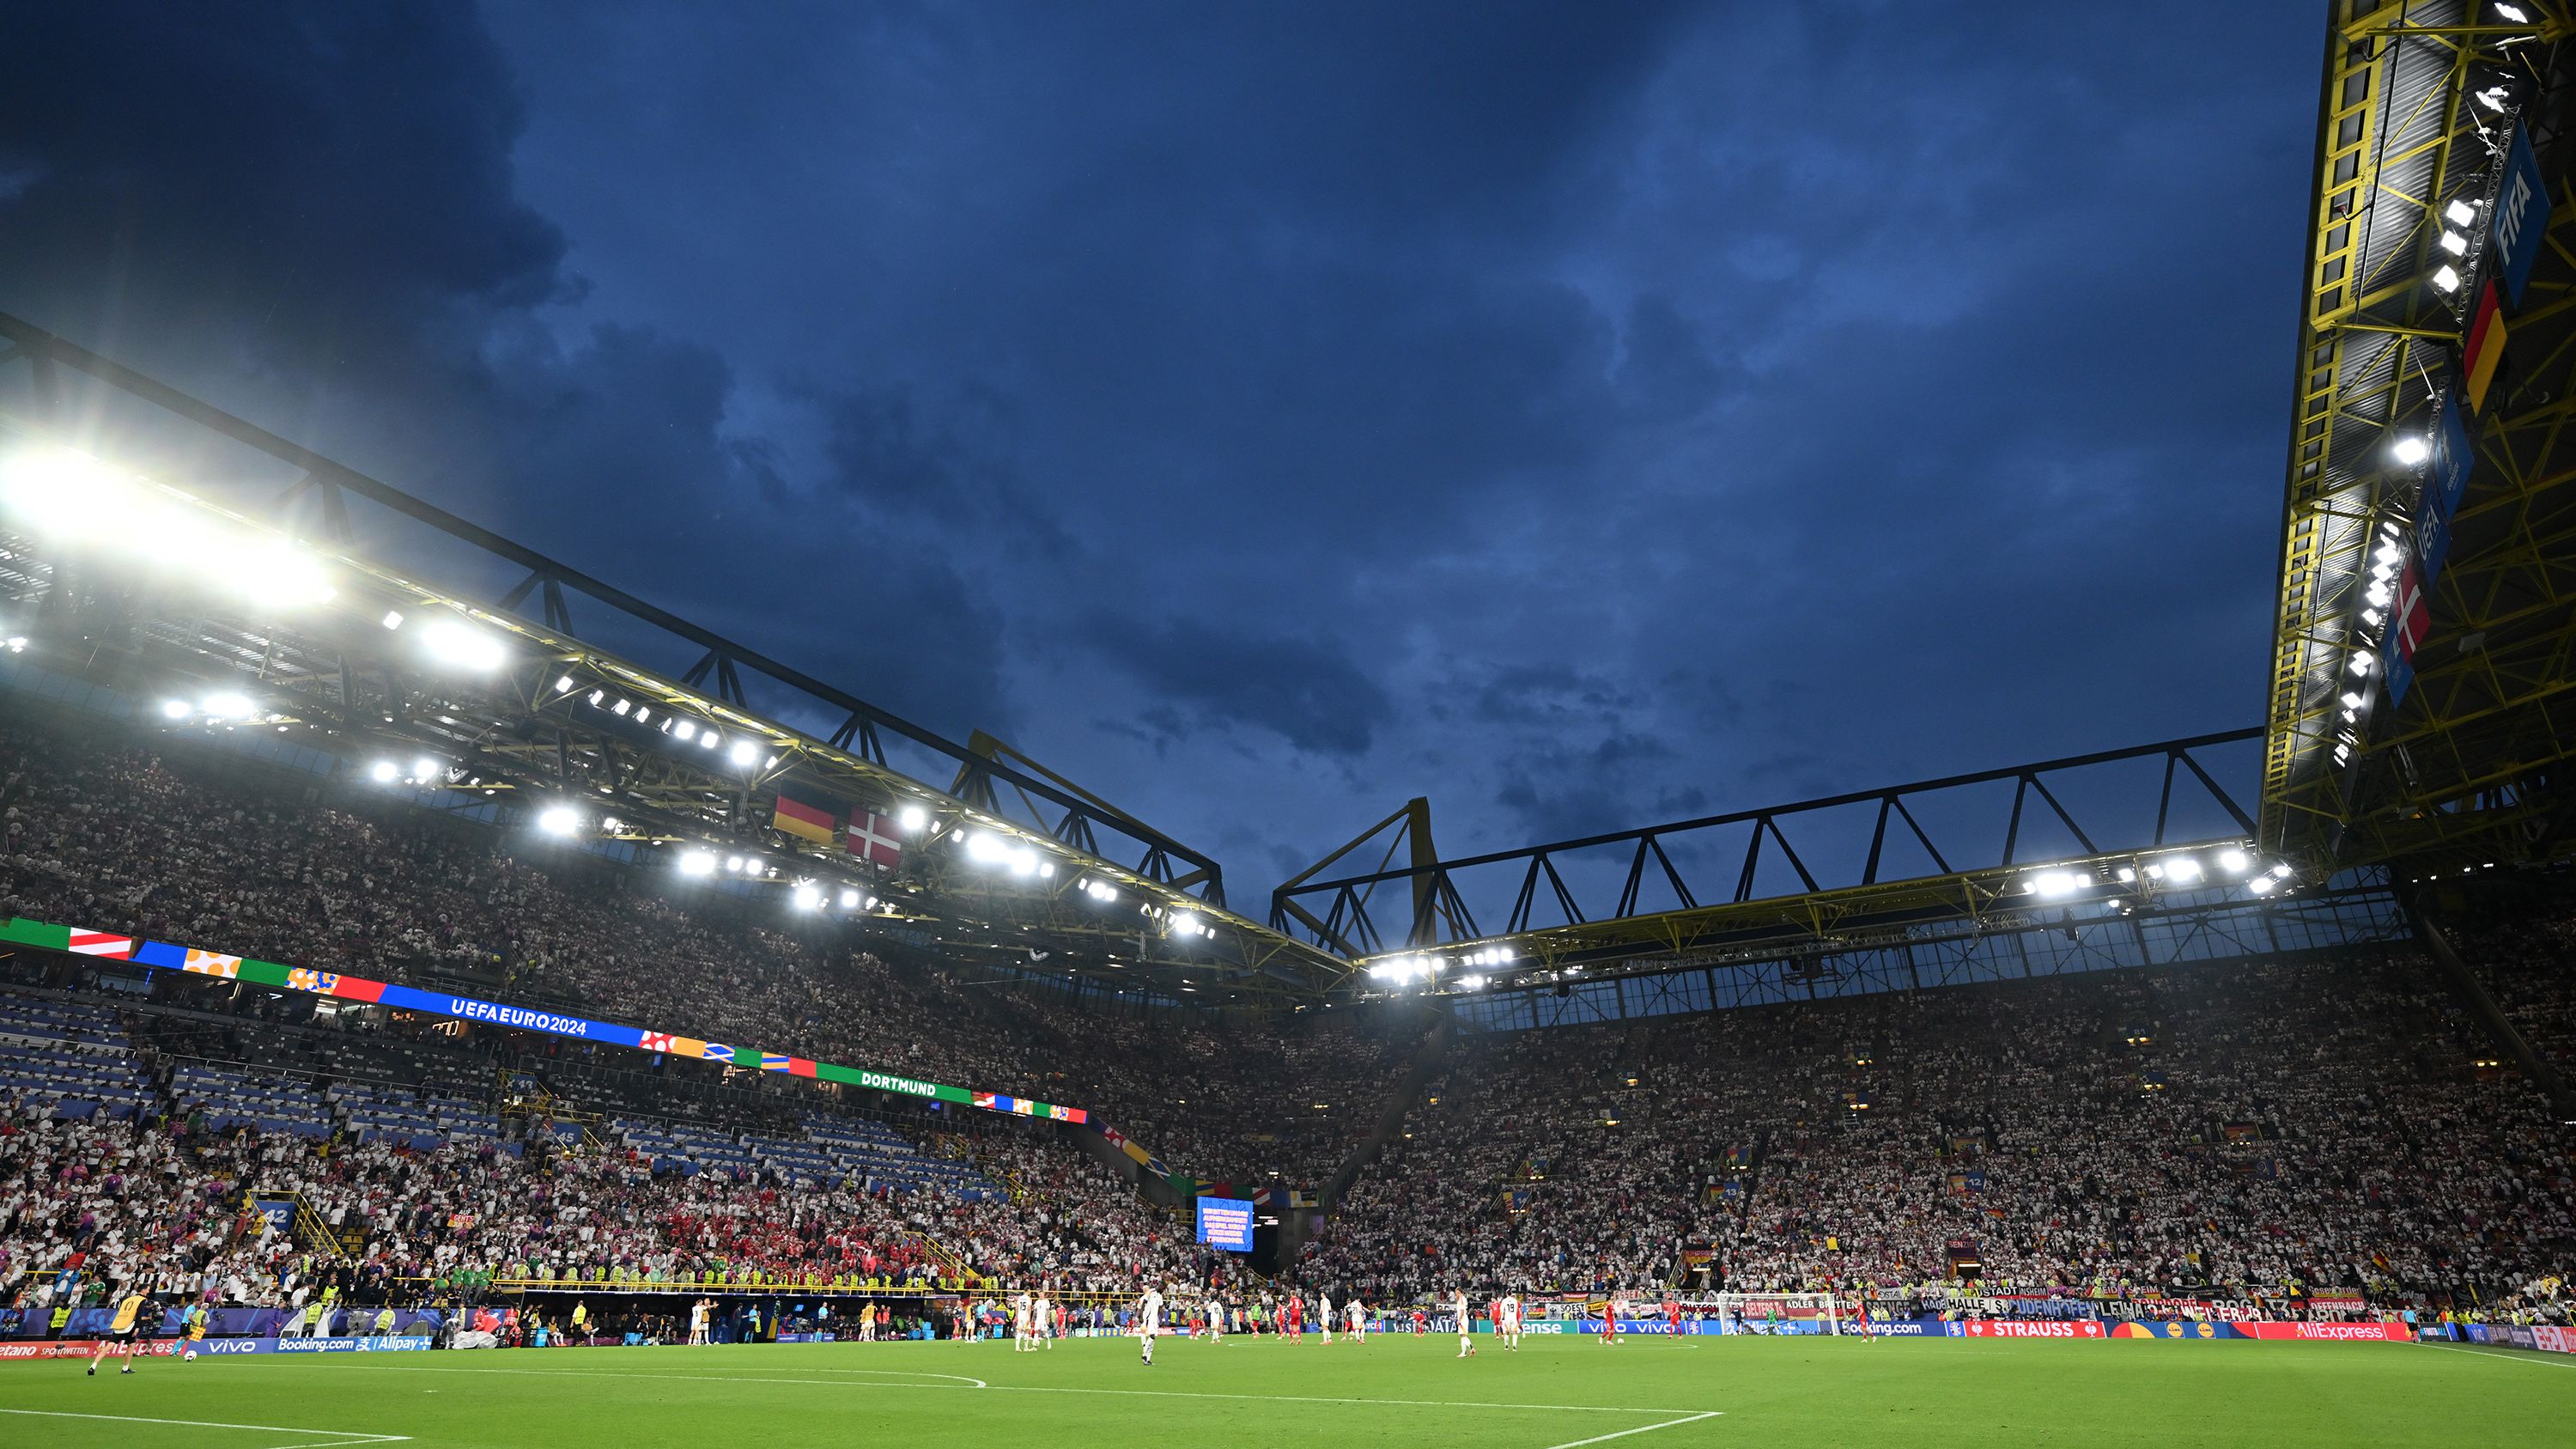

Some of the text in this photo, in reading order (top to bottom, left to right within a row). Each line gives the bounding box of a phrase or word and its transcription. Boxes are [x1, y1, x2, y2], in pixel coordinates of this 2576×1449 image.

[2499, 170, 2531, 267] FIFA
[2418, 504, 2439, 561] UEFA
[861, 1072, 936, 1096] DORTMUND
[565, 1131, 583, 1142] 45
[1968, 1178, 1982, 1186] 12
[1020, 1301, 1027, 1311] 15
[1506, 1303, 1515, 1312] 19
[1786, 1300, 1814, 1308] ADLER
[1948, 1299, 1986, 1311] HALLE
[1994, 1323, 2075, 1336] STRAUSS
[2295, 1323, 2384, 1340] AliExpress
[209, 1339, 256, 1352] vivo
[278, 1337, 354, 1352] Booking.com
